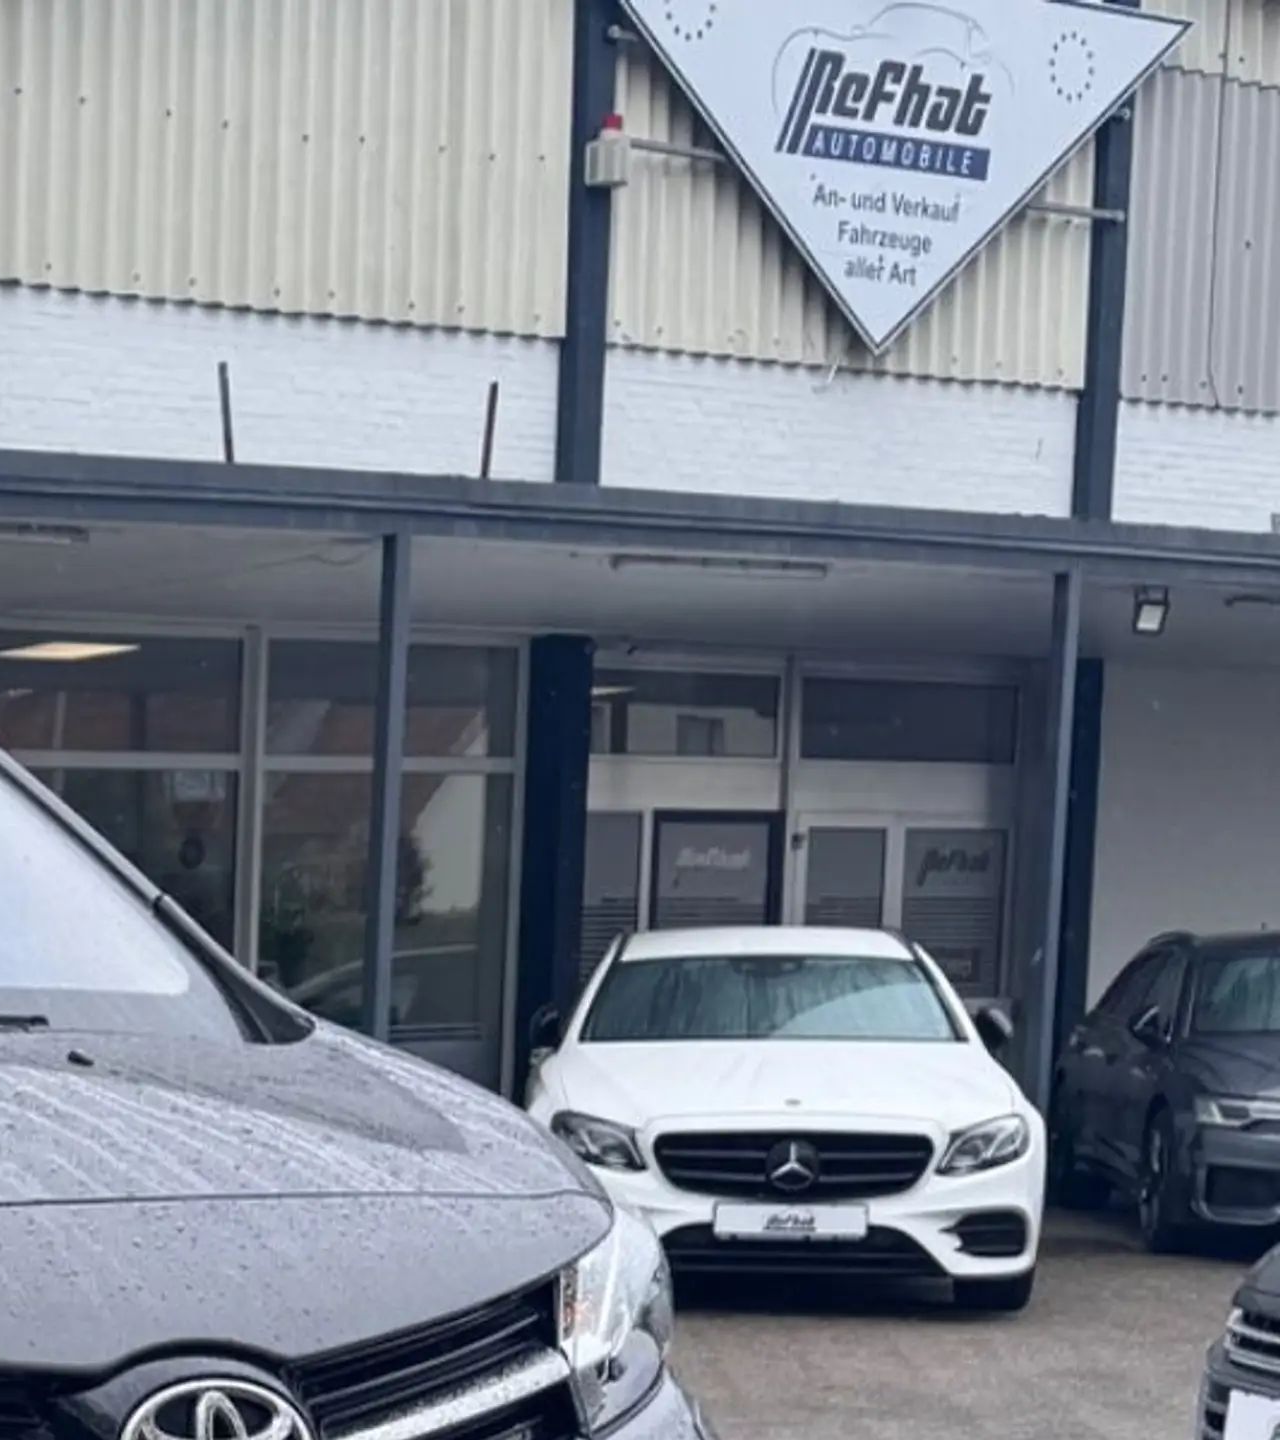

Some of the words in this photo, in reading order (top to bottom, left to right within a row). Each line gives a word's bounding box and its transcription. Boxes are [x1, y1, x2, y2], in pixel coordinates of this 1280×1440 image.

[811, 129, 973, 174] AUTOMOBILE
[812, 184, 846, 208] An-
[851, 192, 886, 214] und
[892, 192, 960, 223] Verkauf
[838, 220, 932, 257] Fahrzeuge
[844, 256, 885, 282] aller
[888, 261, 917, 286] Art
